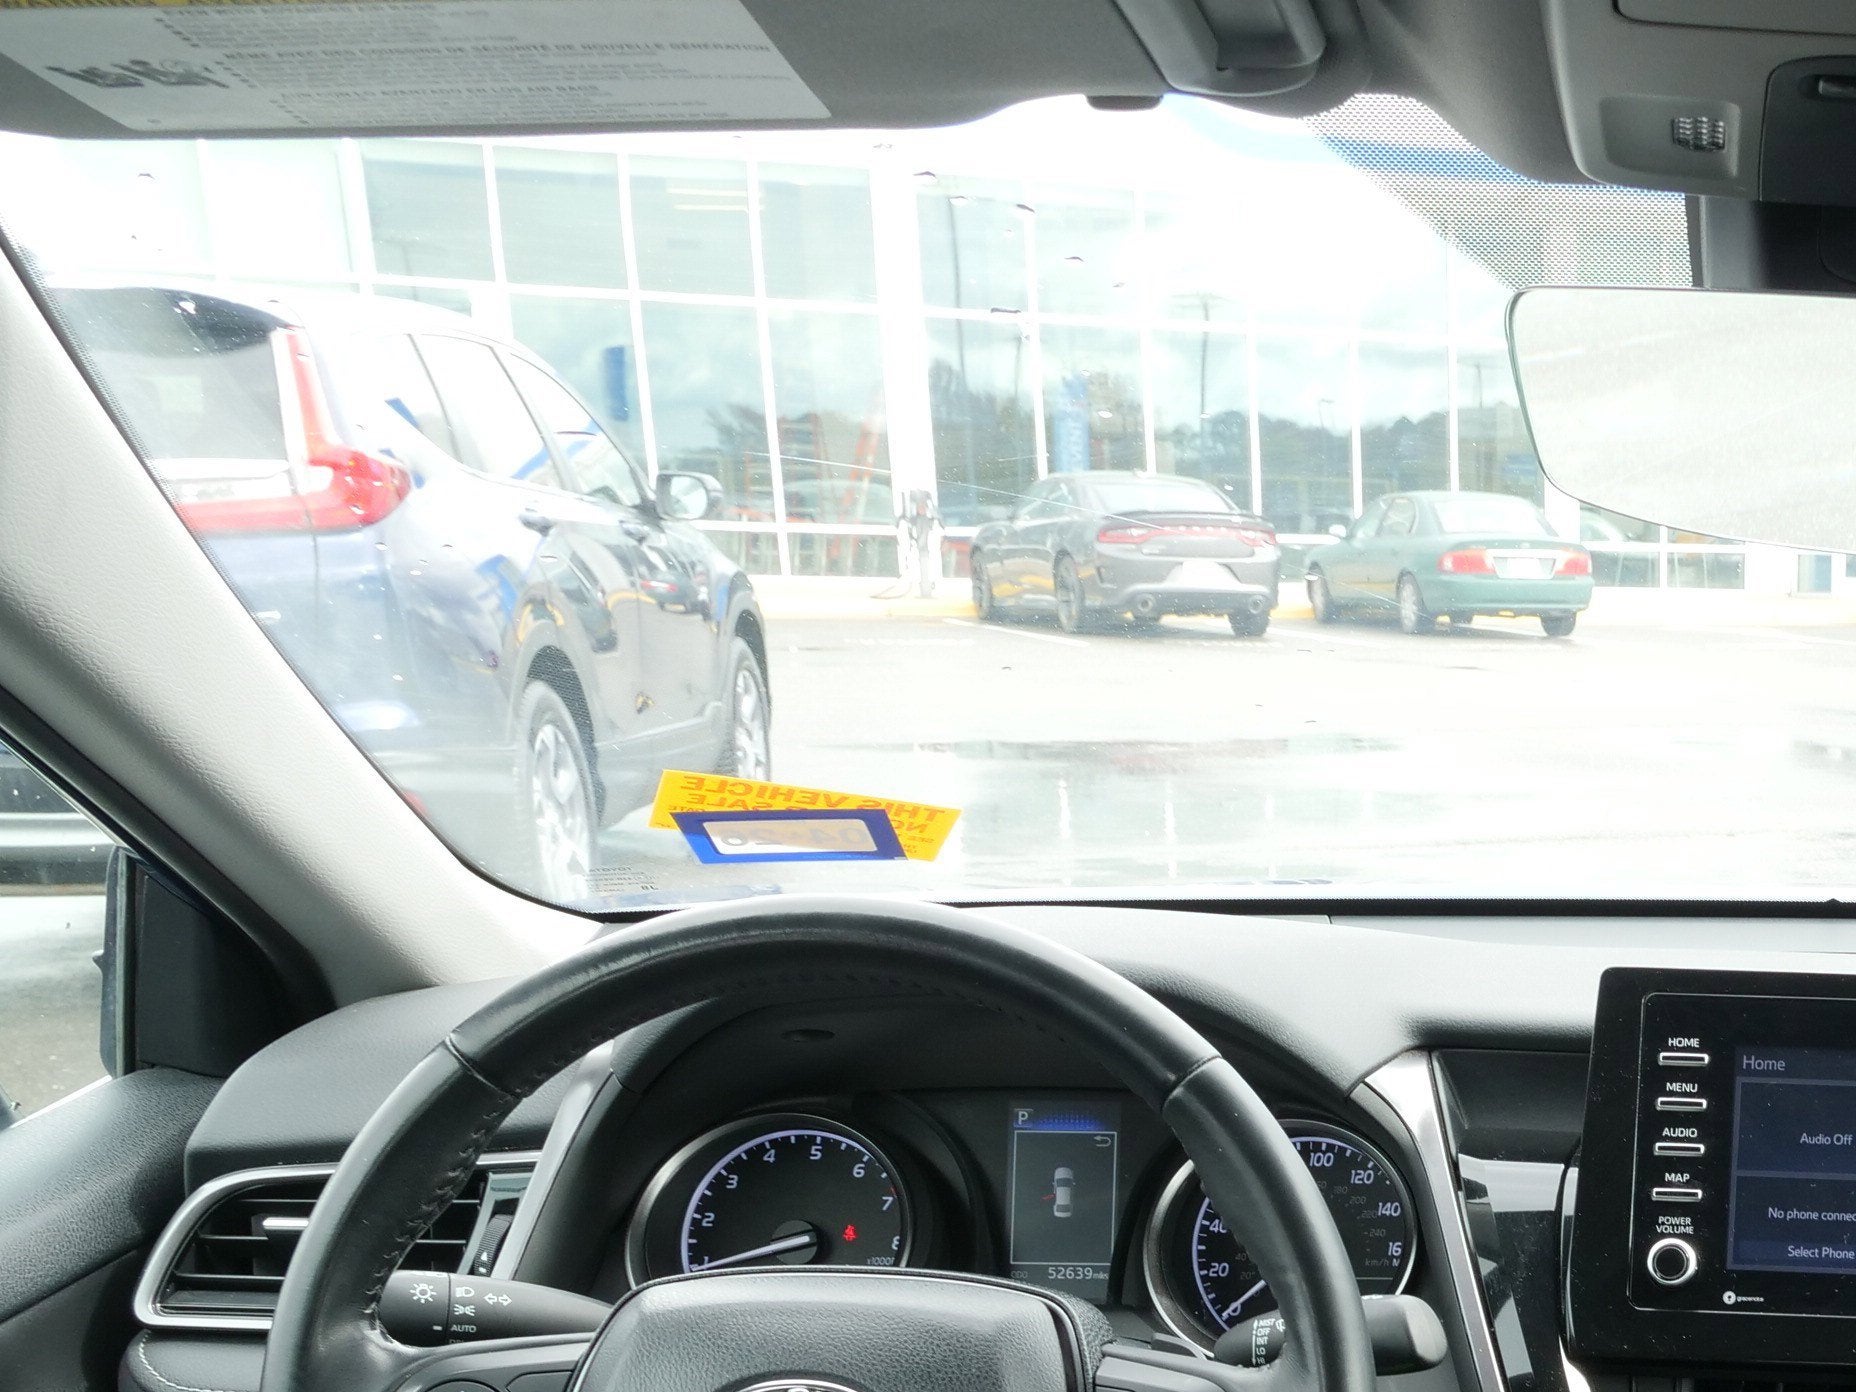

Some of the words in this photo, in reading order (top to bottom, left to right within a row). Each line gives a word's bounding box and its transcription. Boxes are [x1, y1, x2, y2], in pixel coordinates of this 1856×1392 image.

[1668, 1037, 1700, 1048] HOME
[1742, 1055, 1786, 1071] Home
[1666, 1082, 1698, 1093] MENU
[1018, 1111, 1029, 1125] P
[1662, 1127, 1698, 1138] AUDIO
[1800, 1132, 1832, 1146] Audio
[1833, 1133, 1853, 1146] Off
[763, 1149, 776, 1163] 4
[810, 1146, 822, 1160] 5
[1309, 1152, 1334, 1167] 100
[852, 1163, 866, 1178] 6
[1350, 1169, 1374, 1184] 120
[1664, 1172, 1690, 1183] MAP
[726, 1174, 738, 1189] 3
[882, 1196, 894, 1211] 7
[1378, 1202, 1401, 1217] 140
[701, 1213, 715, 1227] 2
[1658, 1216, 1691, 1226] POWER
[1768, 1207, 1785, 1219] No
[1786, 1208, 1819, 1222] phone
[1655, 1225, 1694, 1235] VOLUME
[1787, 1246, 1819, 1258] Select
[1821, 1247, 1855, 1260] Phone
[1048, 1267, 1093, 1280] 52639
[1208, 1262, 1229, 1277] 20
[450, 1325, 477, 1333] AUTO
[1257, 1328, 1270, 1336] OFF
[1256, 1337, 1268, 1345] INT
[1256, 1347, 1265, 1355] LO
